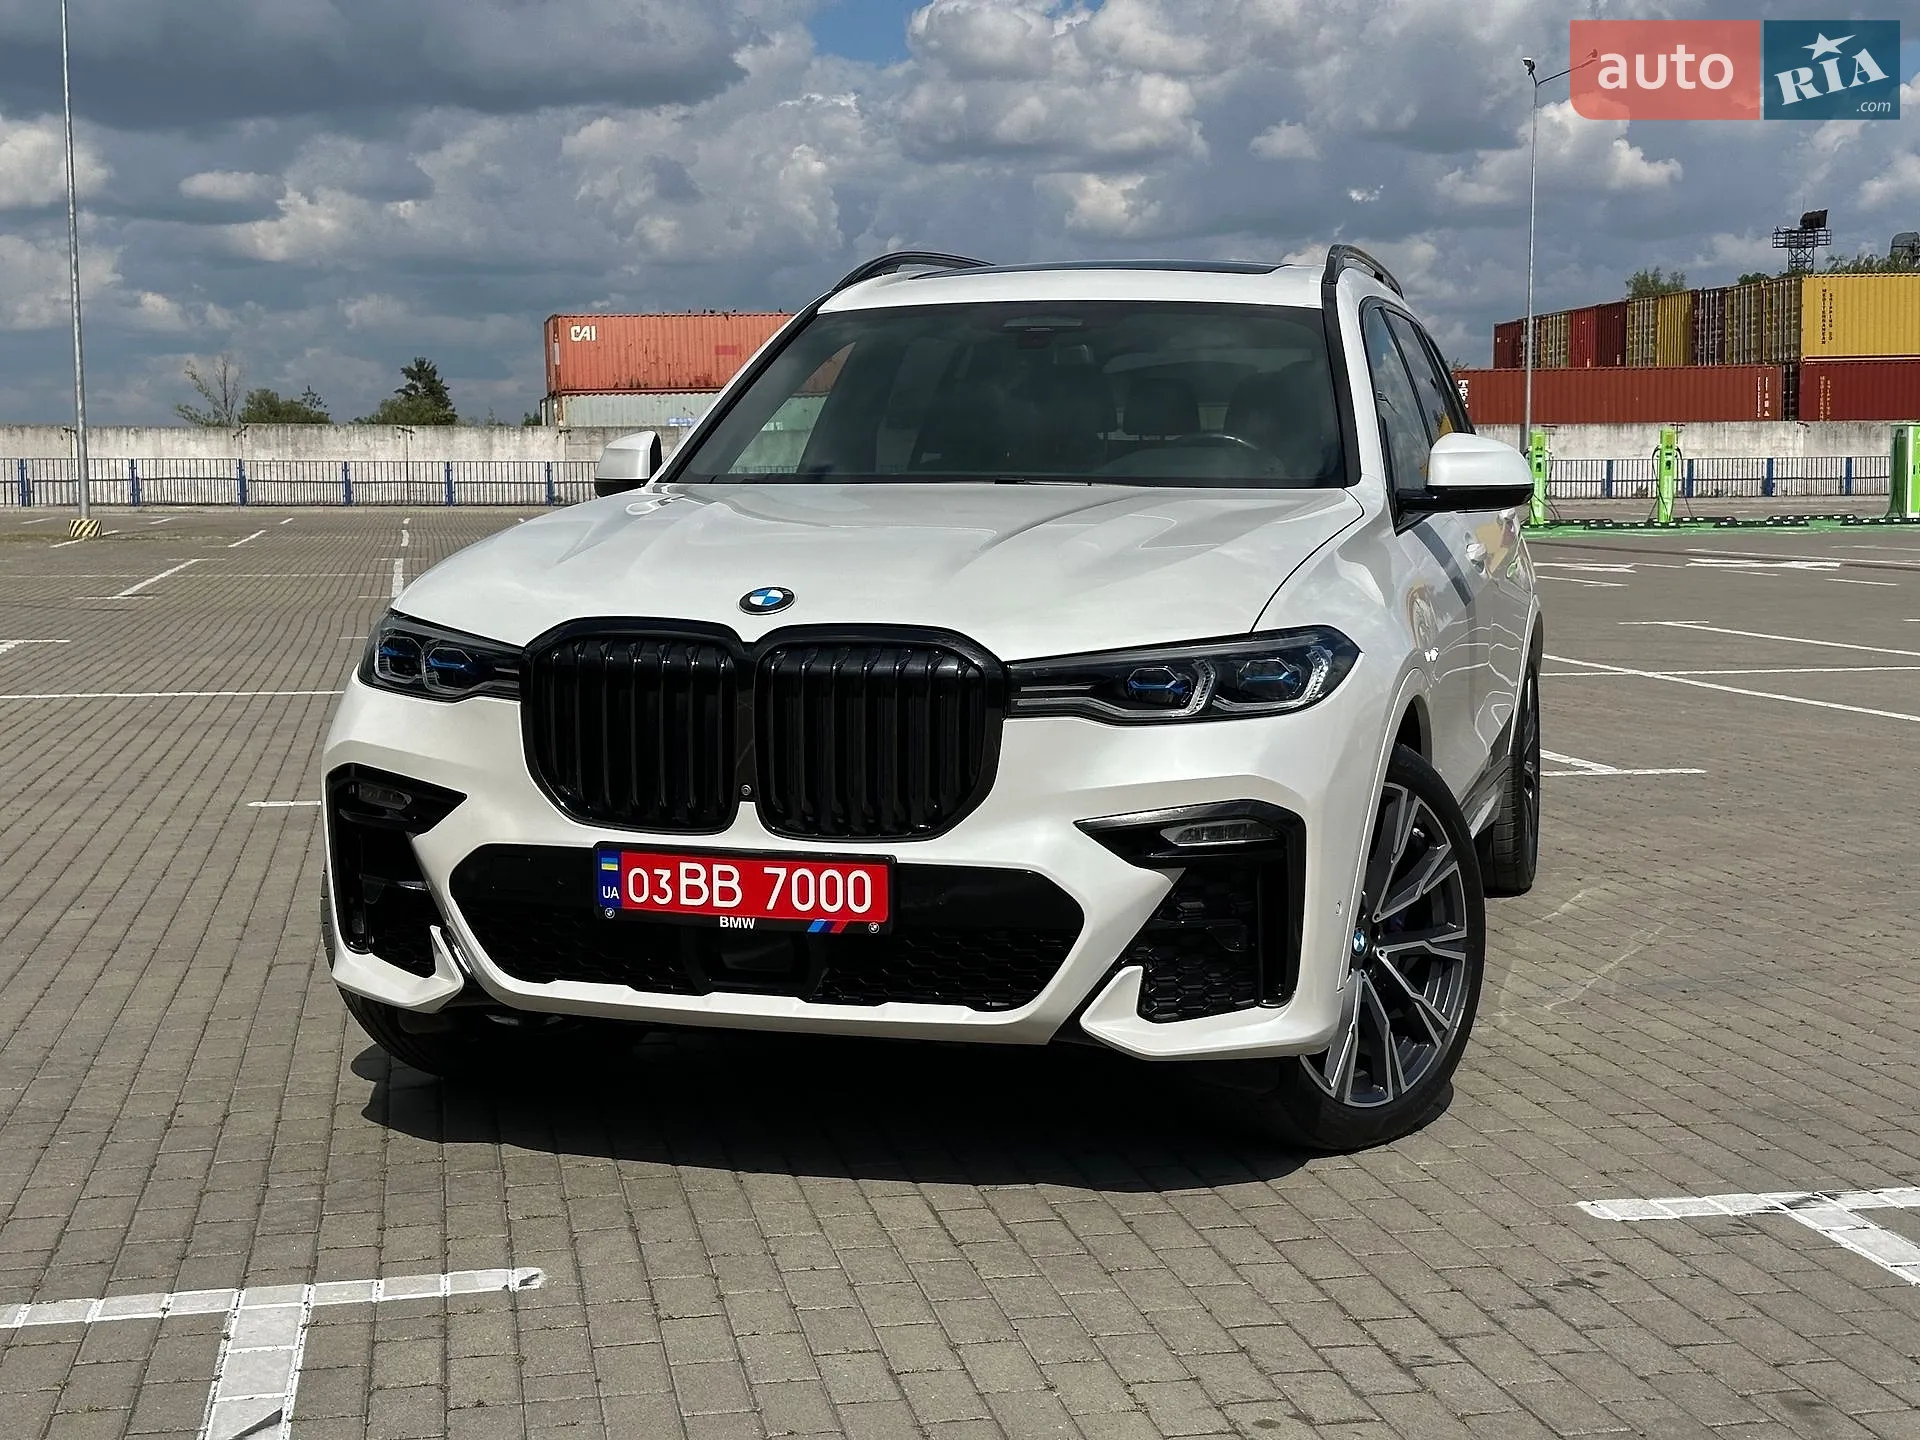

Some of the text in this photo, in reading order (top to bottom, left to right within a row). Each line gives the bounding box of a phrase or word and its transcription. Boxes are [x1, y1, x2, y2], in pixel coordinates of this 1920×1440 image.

[570, 325, 597, 342] CAI
[602, 886, 620, 900] UA
[763, 867, 873, 914] 7000
[719, 915, 756, 930] BMW
